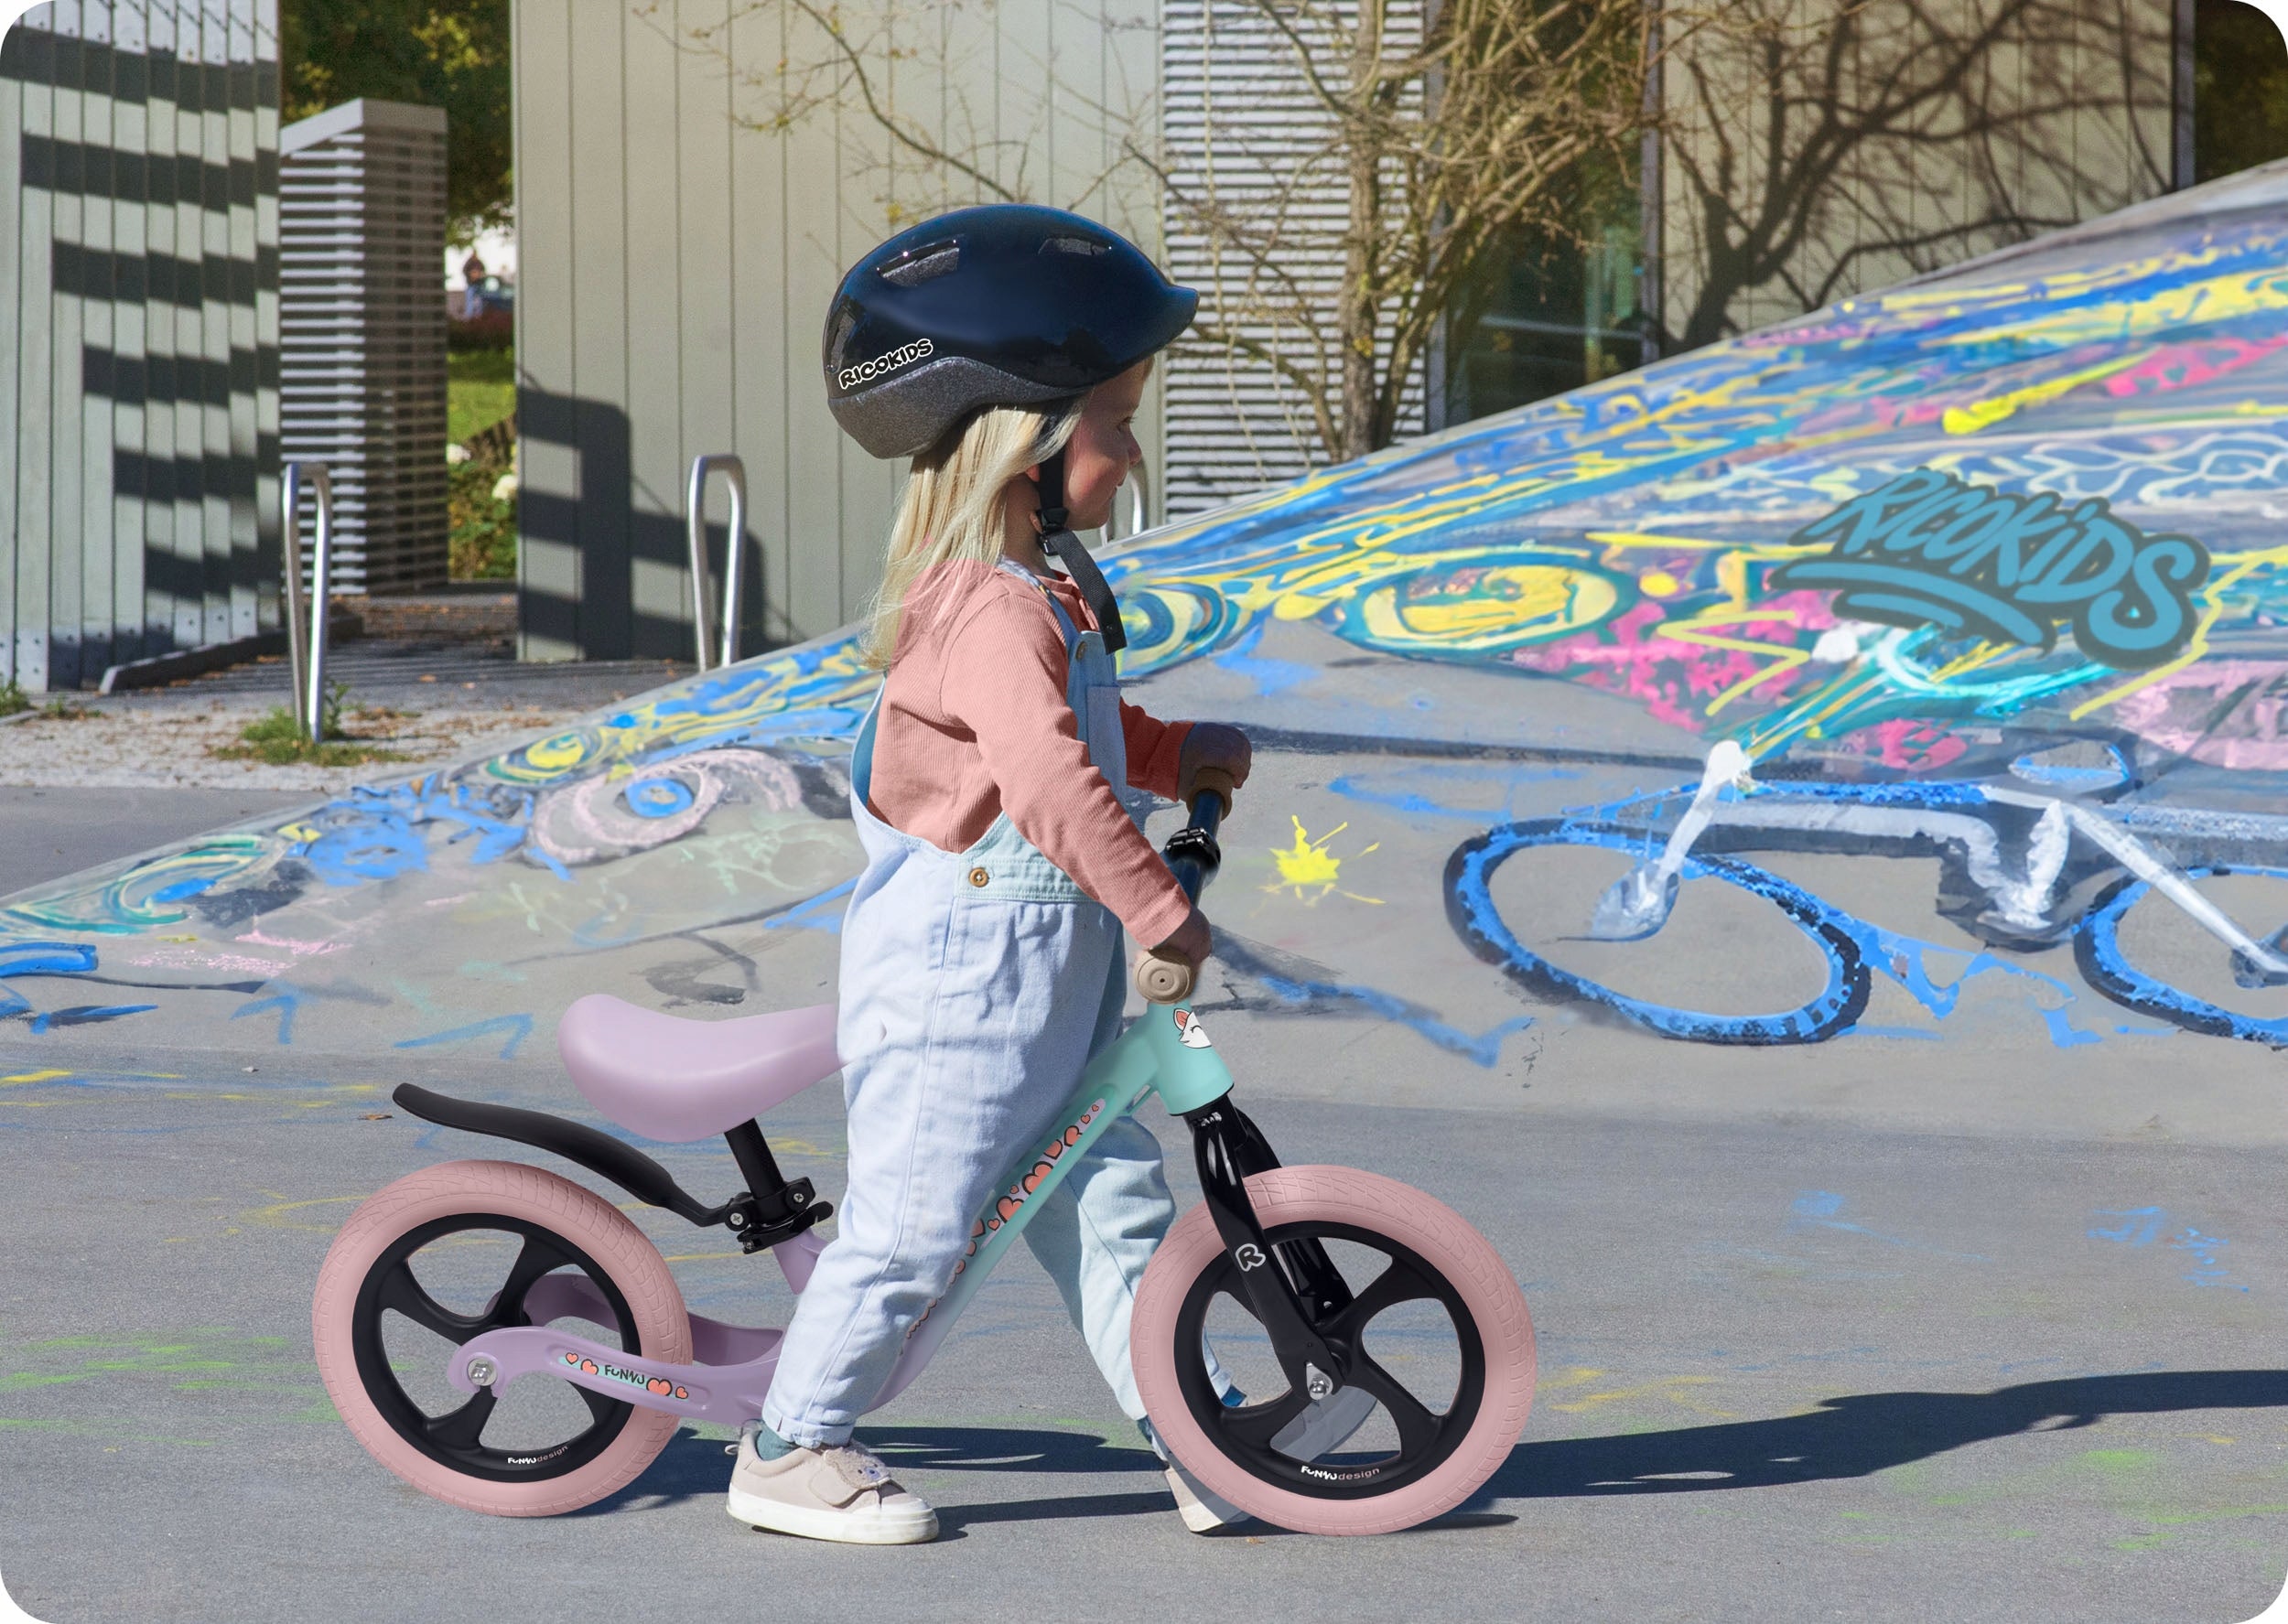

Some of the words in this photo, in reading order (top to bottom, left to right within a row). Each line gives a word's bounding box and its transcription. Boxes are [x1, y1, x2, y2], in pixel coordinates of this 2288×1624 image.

[838, 338, 934, 390] RICOKIDS
[1235, 1242, 1267, 1272] R
[537, 1446, 568, 1462] design
[1338, 1468, 1380, 1480] design
